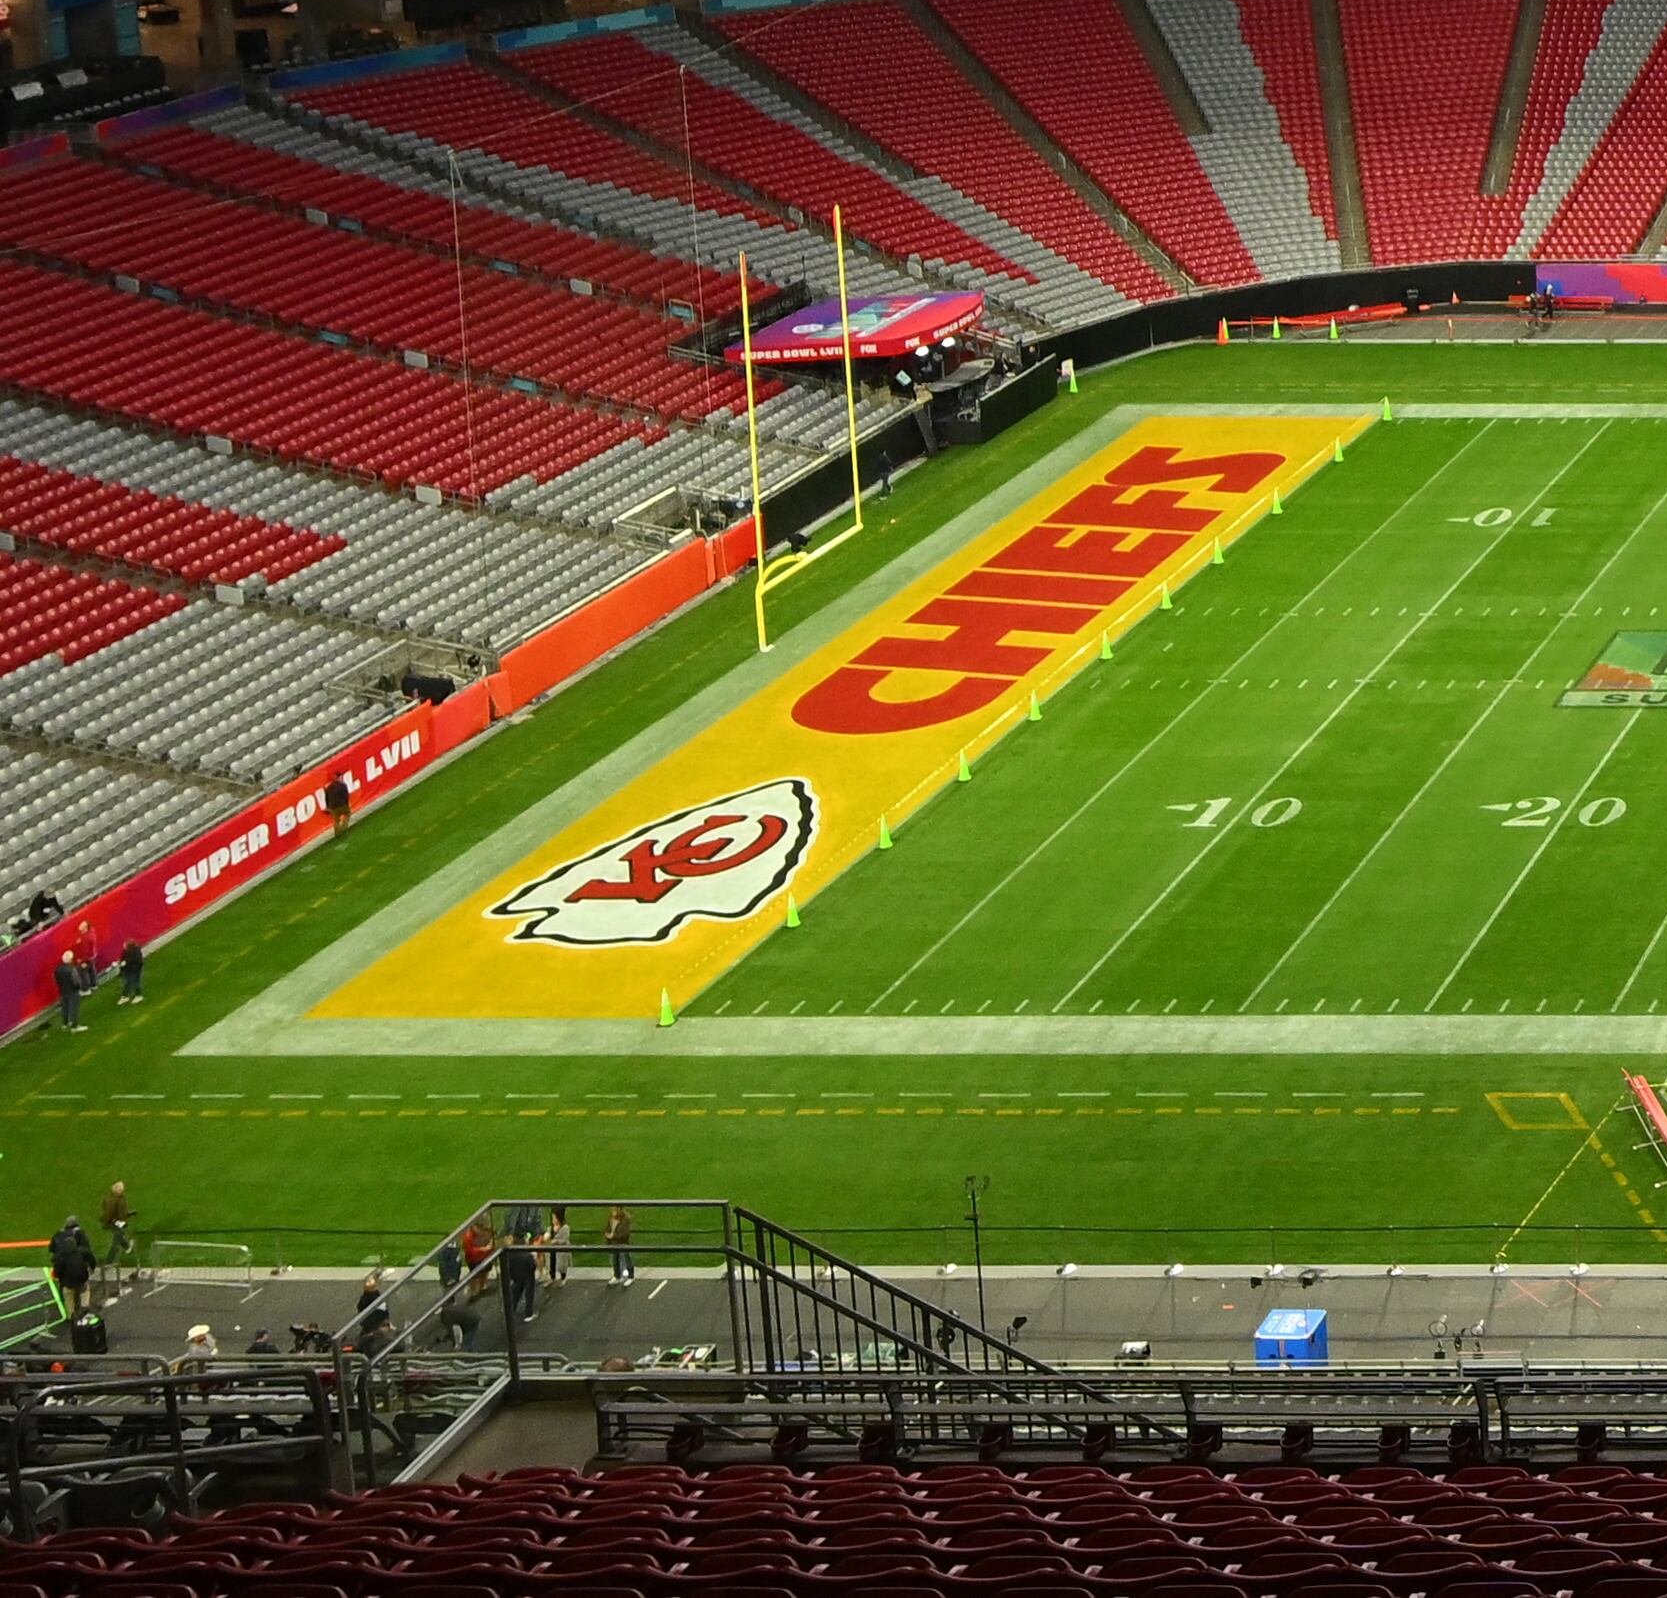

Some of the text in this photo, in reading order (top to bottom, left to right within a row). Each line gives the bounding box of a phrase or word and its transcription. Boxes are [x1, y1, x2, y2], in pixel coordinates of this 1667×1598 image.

[783, 348, 817, 359] BOWL
[860, 344, 877, 354] FOX
[905, 336, 920, 349] FOX
[791, 445, 1286, 736] CHIEFS
[164, 823, 269, 905] SUPER
[365, 730, 421, 782] LVII
[1182, 797, 1303, 828] 10
[1501, 796, 1627, 827] 20
[563, 814, 789, 904] KC
